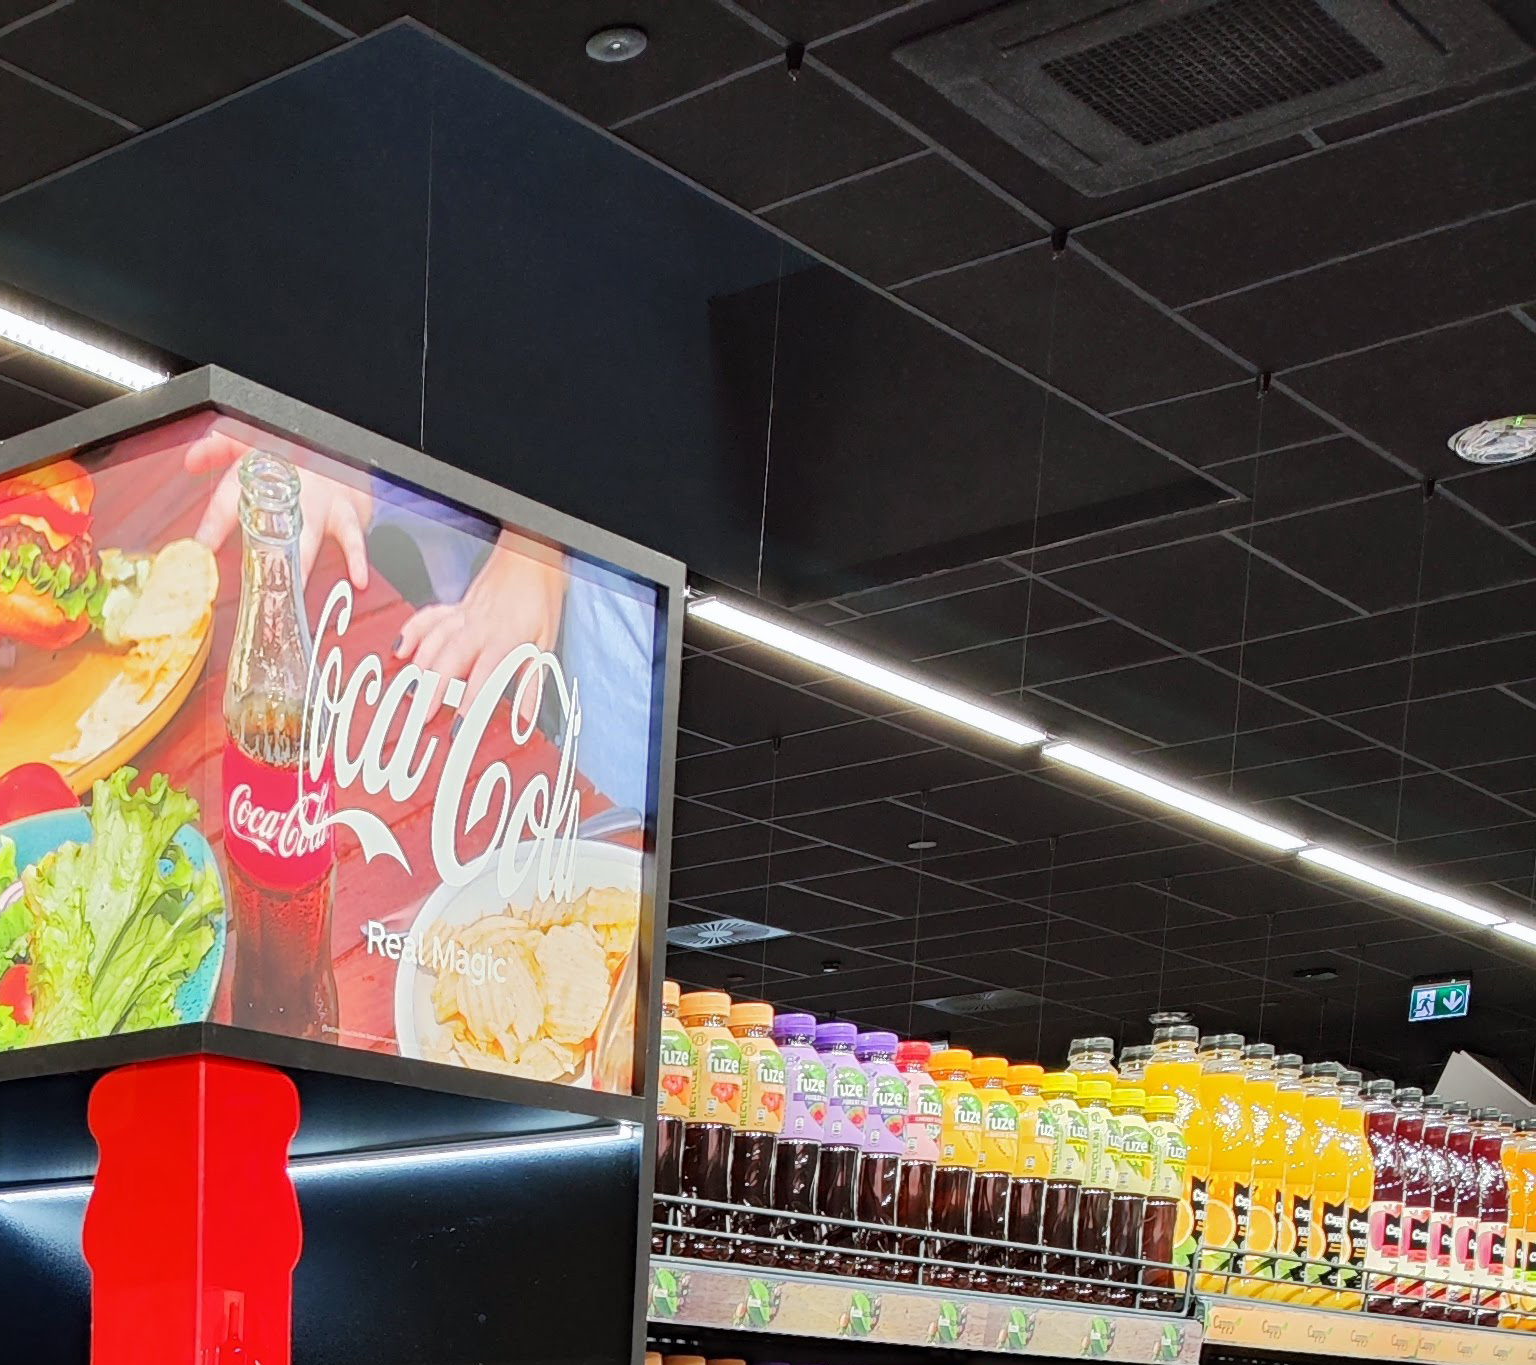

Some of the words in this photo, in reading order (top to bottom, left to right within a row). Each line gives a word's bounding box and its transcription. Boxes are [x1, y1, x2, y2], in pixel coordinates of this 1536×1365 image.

[298, 578, 581, 904] Coca-Cola
[367, 920, 425, 967] Real
[433, 935, 507, 985] Magic
[707, 1052, 740, 1074] fuze
[756, 1063, 785, 1084] fuze
[795, 1074, 825, 1095] fuze
[832, 1077, 862, 1097] fuze
[872, 1085, 902, 1106] fuze
[986, 1111, 1015, 1131] fuze
